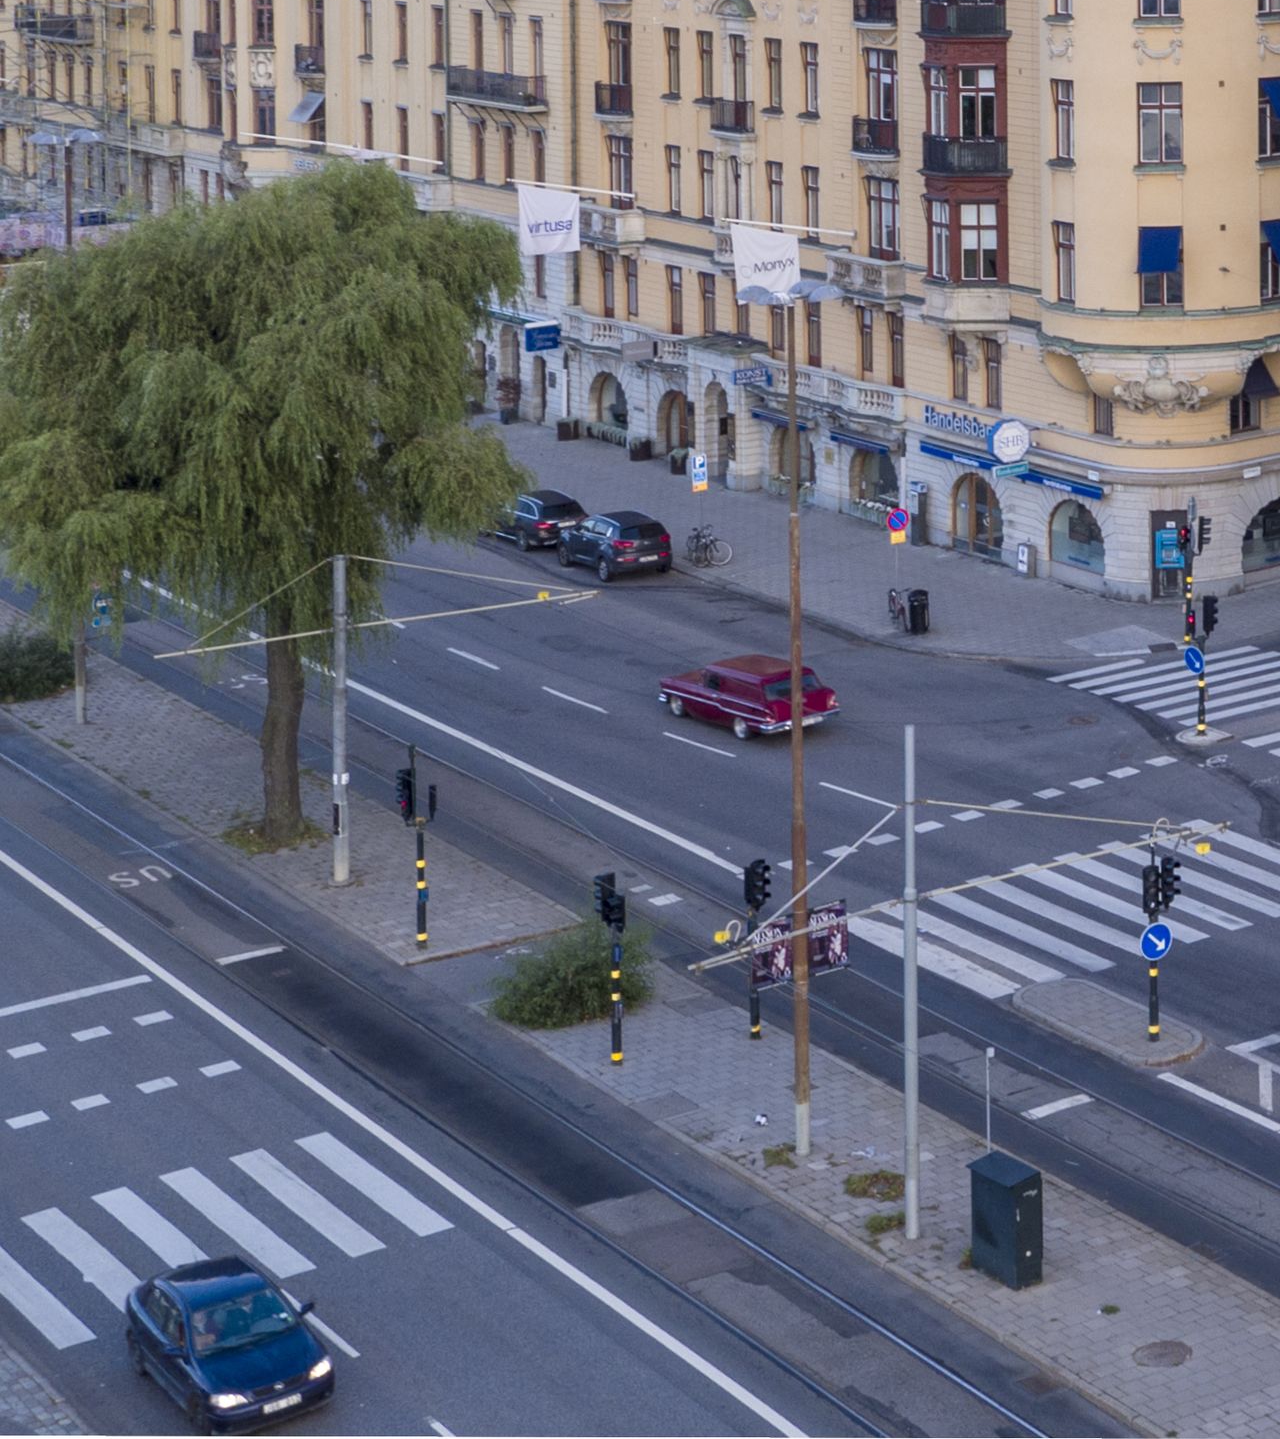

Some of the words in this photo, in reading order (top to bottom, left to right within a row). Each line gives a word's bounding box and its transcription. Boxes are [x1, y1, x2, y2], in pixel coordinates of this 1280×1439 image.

[528, 217, 573, 234] virtusa
[753, 257, 796, 278] Monyx
[1000, 434, 1024, 449] SHB
[696, 456, 704, 469] P
